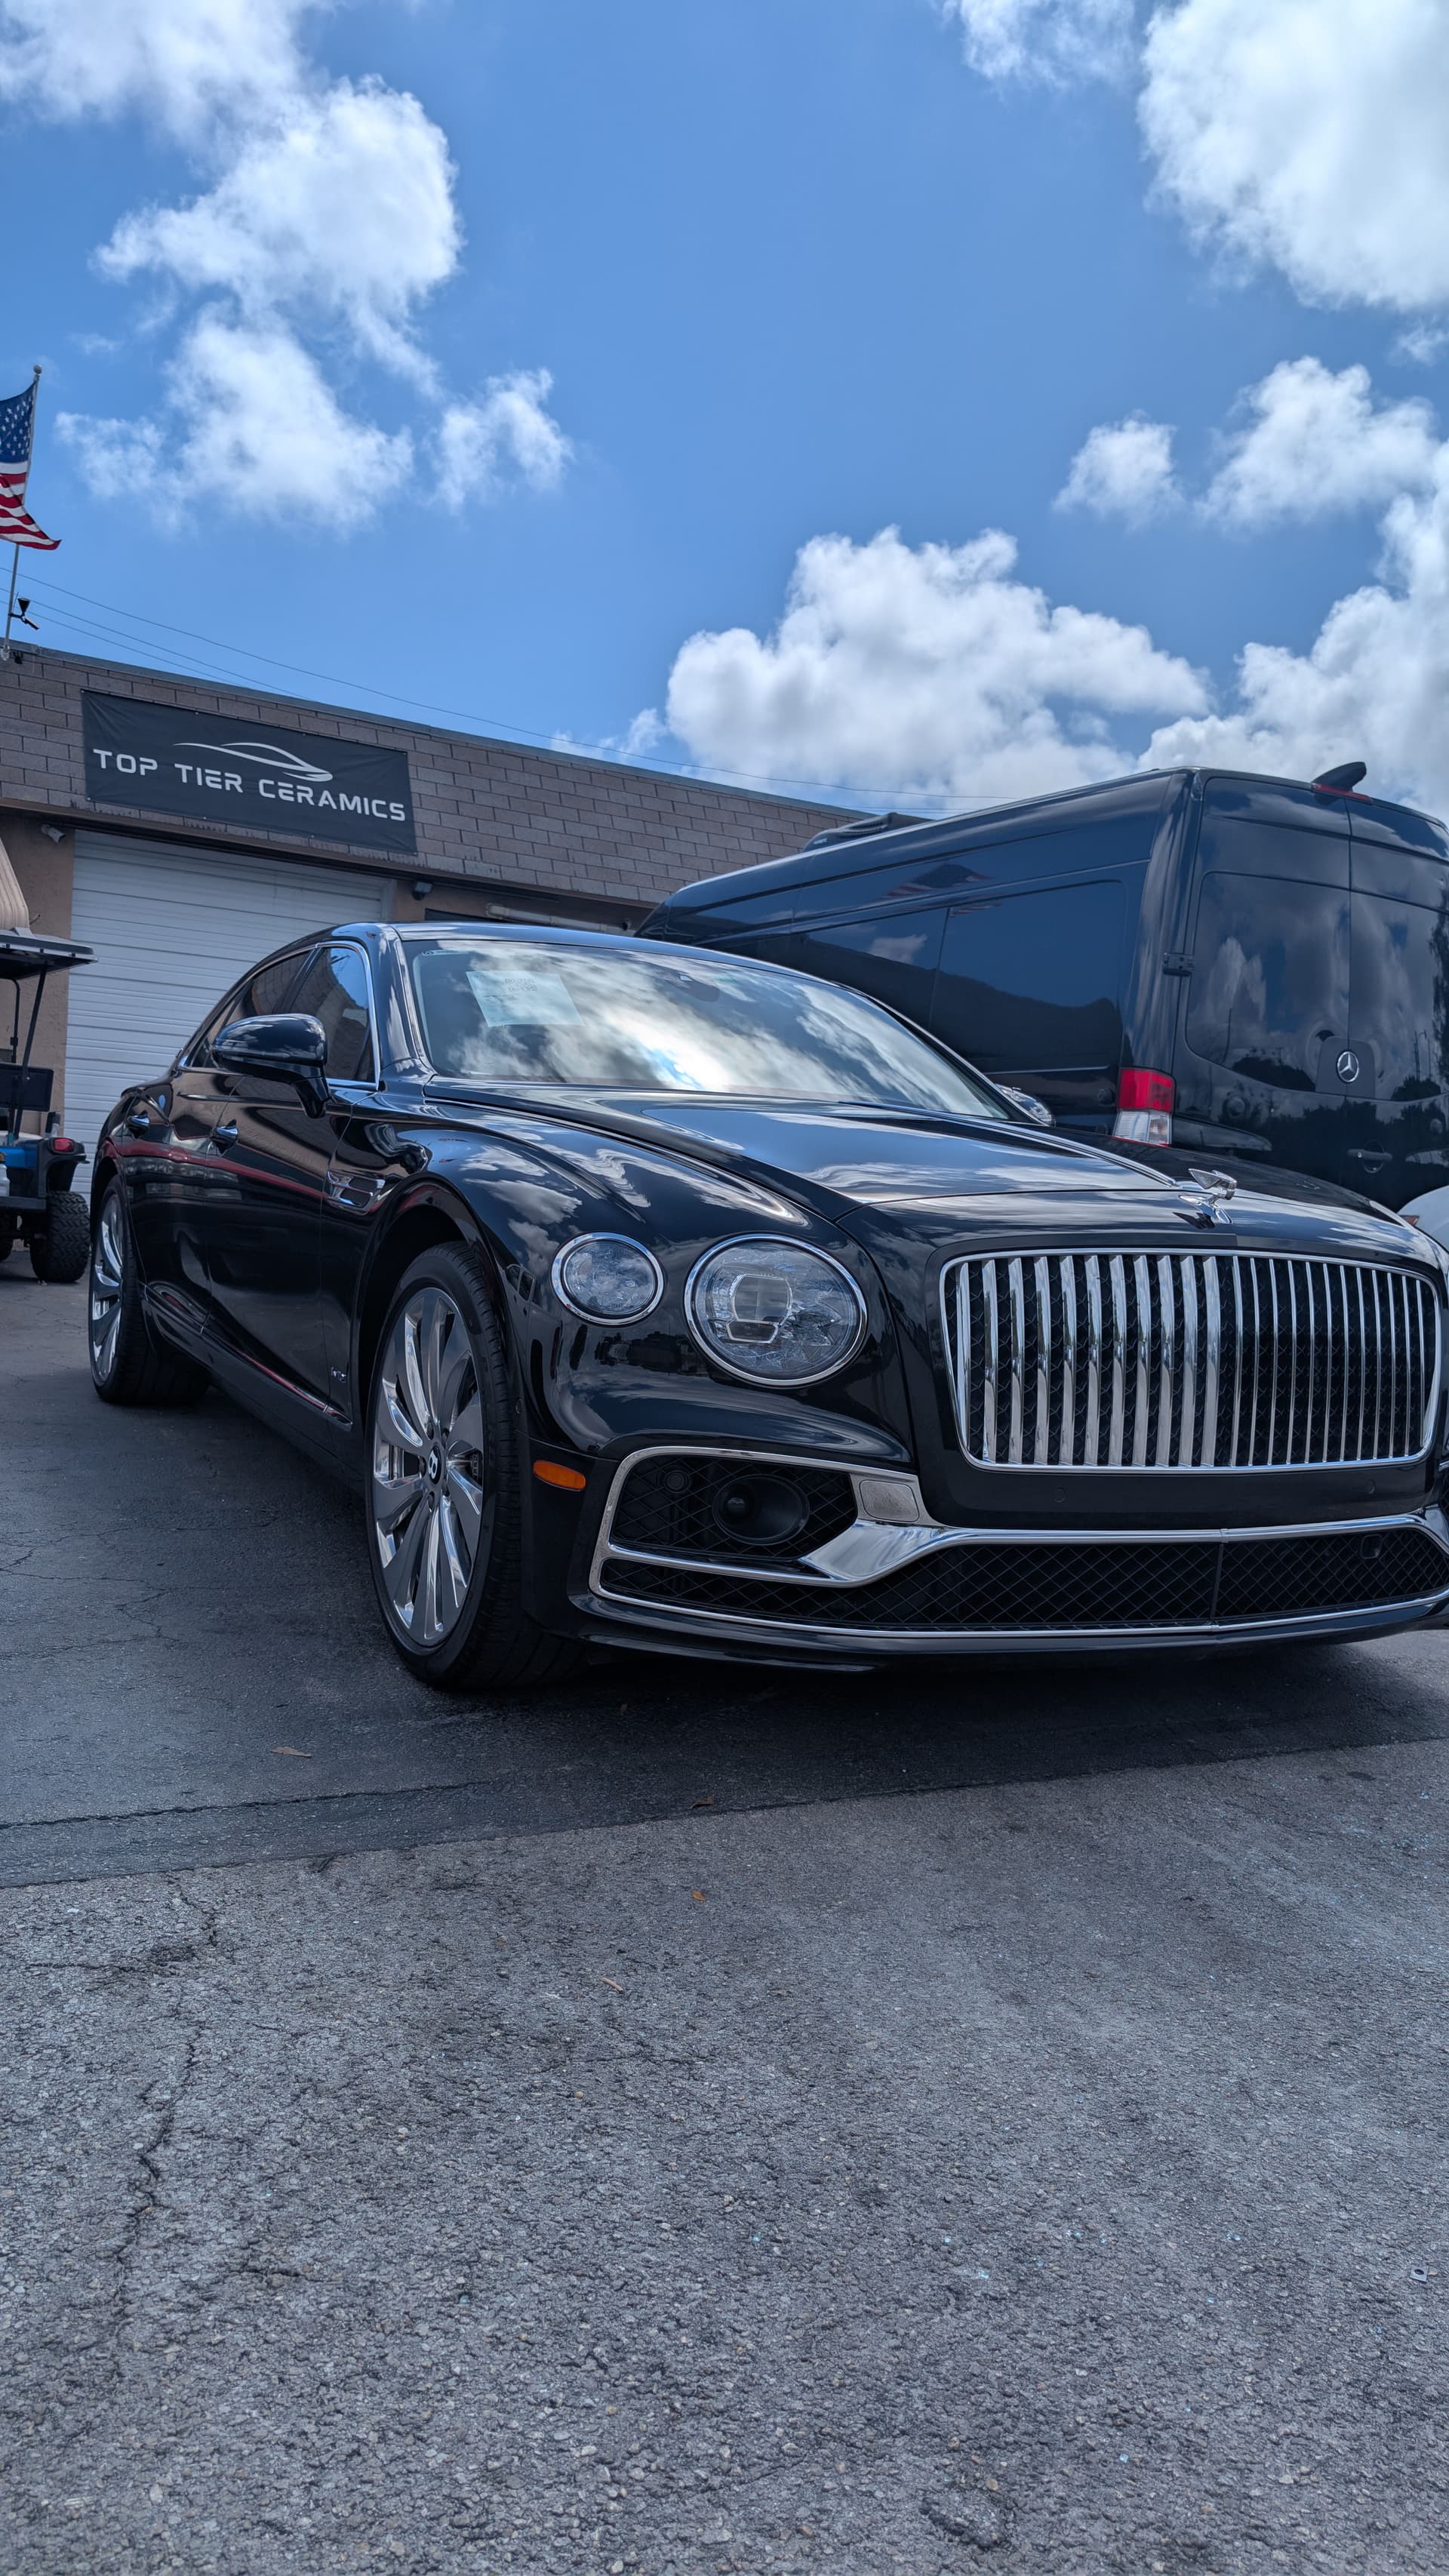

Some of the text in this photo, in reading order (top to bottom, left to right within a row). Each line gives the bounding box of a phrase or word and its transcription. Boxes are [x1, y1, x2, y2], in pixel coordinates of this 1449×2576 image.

[93, 748, 406, 821] TOP TIER CERAMICS
